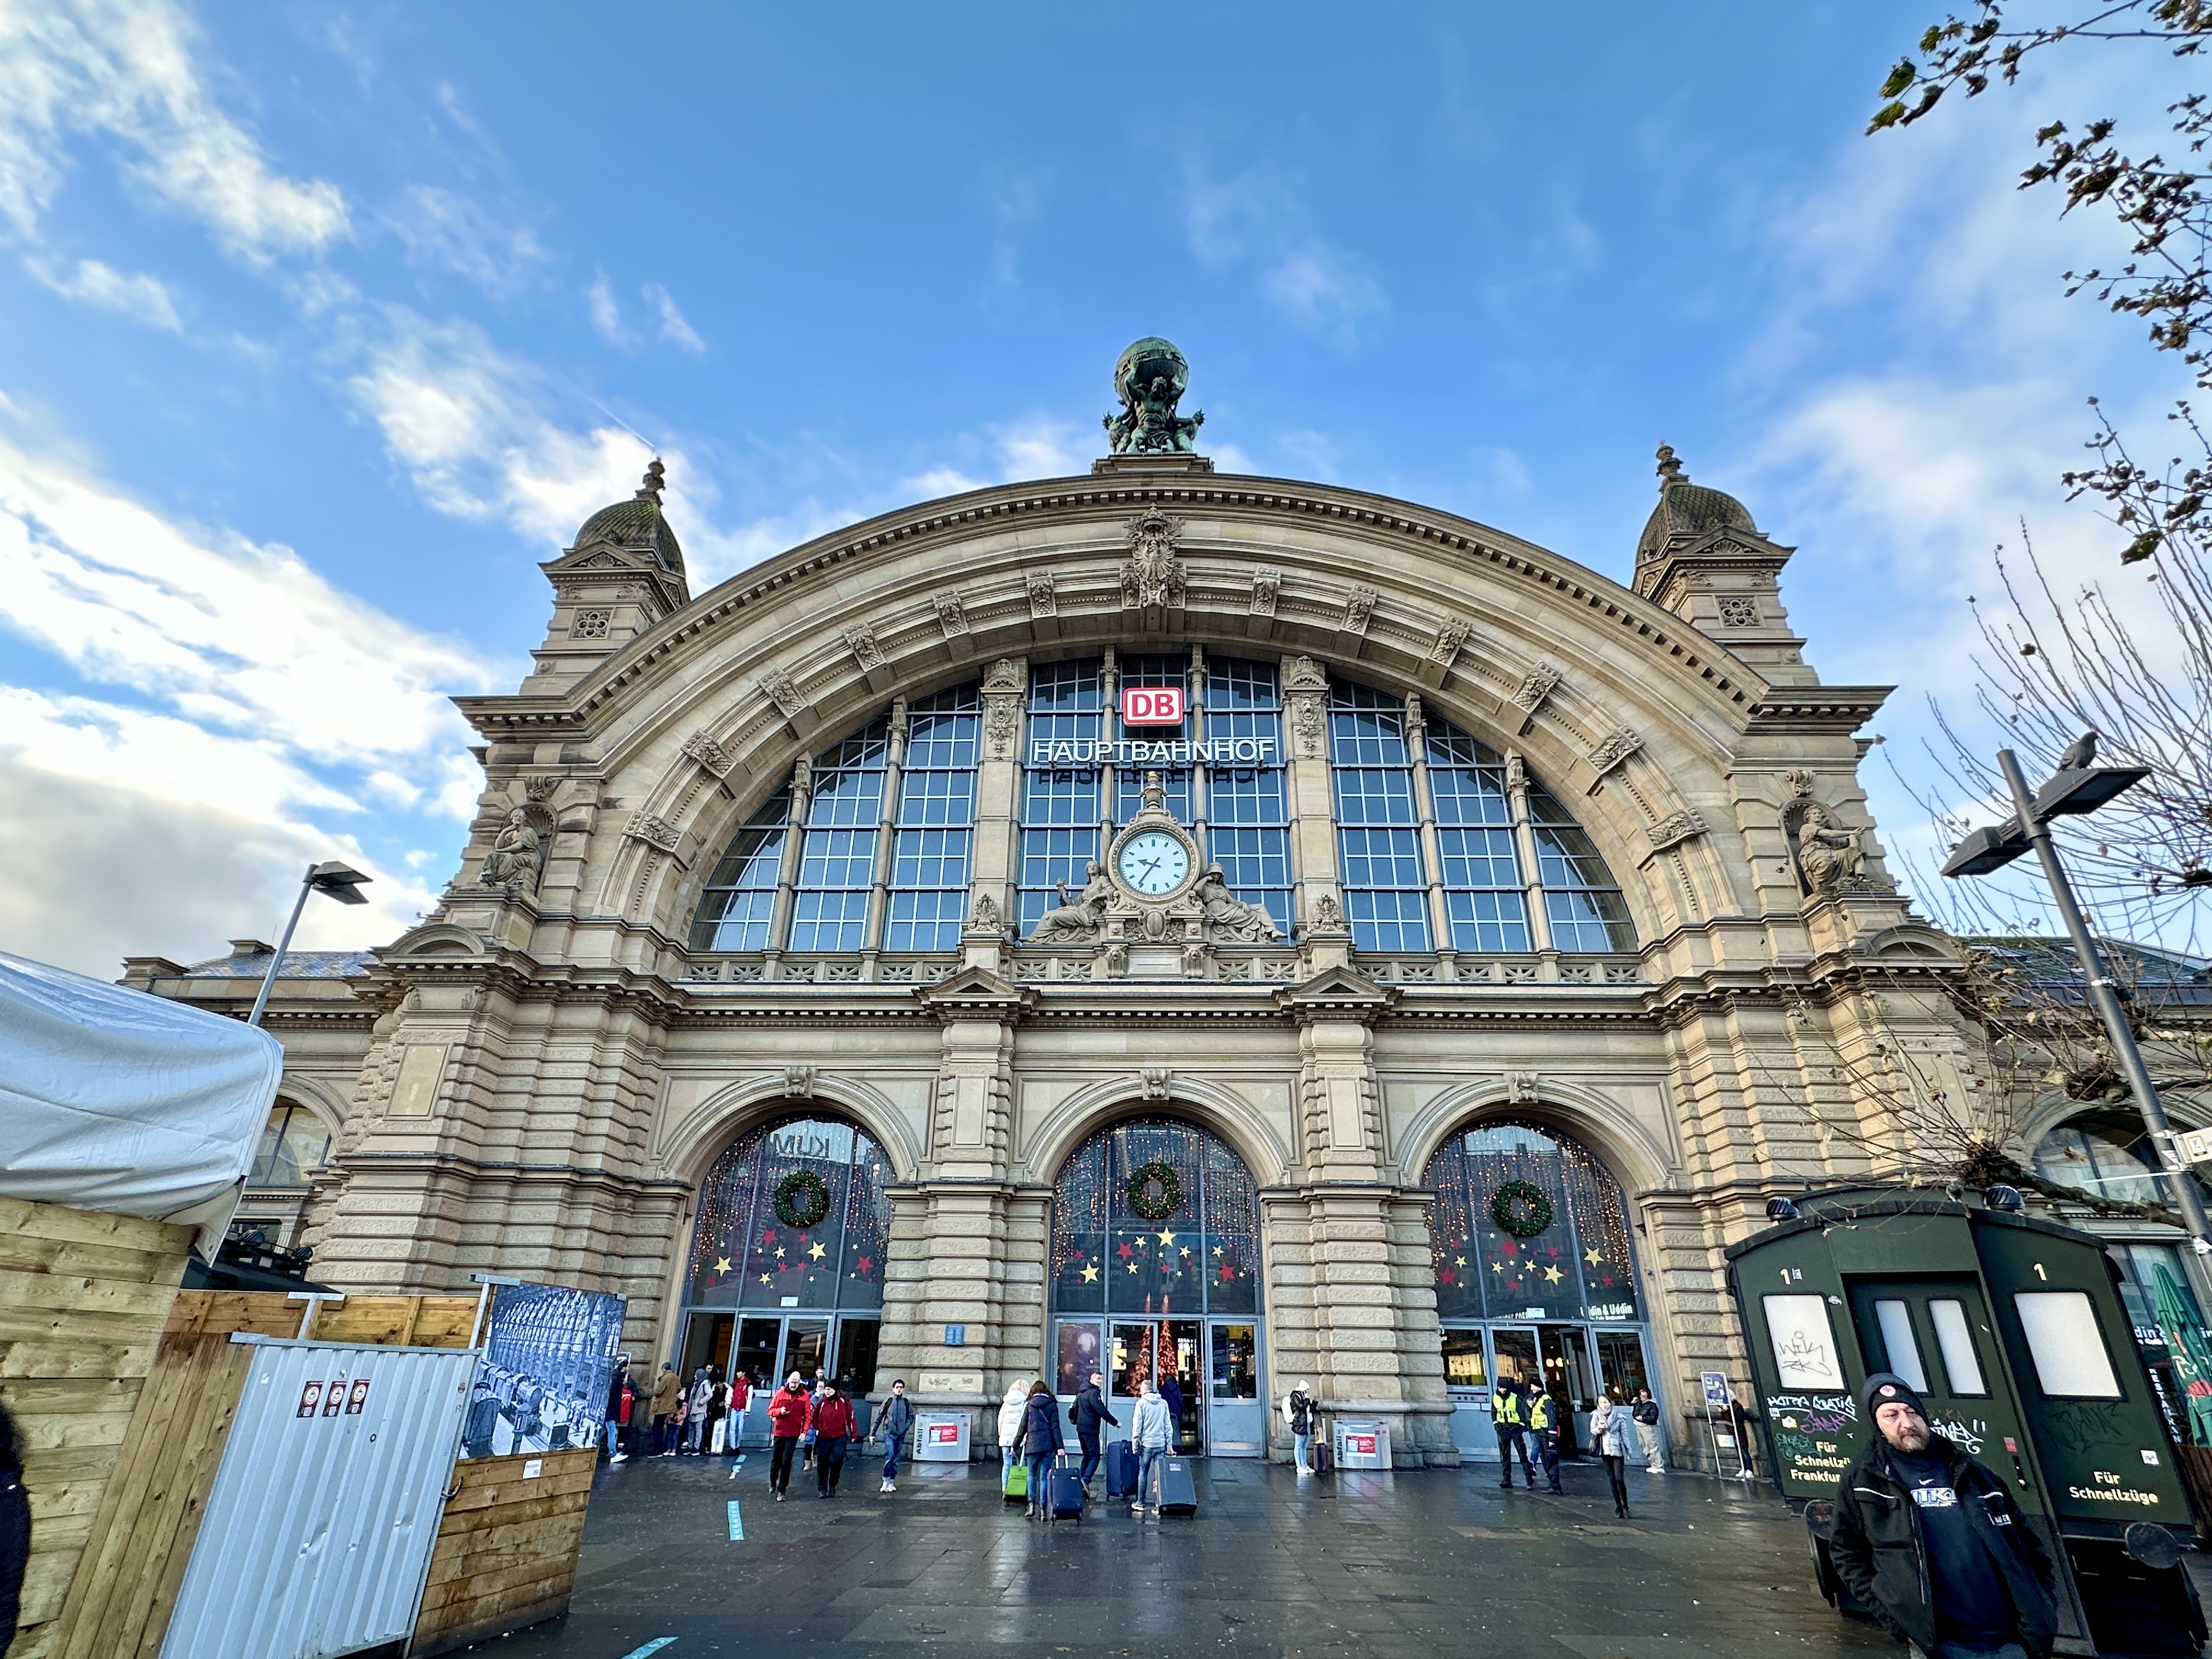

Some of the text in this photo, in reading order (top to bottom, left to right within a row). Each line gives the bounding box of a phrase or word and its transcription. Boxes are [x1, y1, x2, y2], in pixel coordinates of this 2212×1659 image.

[1131, 693, 1175, 717] DB
[1034, 739, 1274, 762] HAUPTBAHNHOF
[1780, 1268, 1791, 1285] 1
[2033, 1263, 2047, 1281] 1
[1602, 1304, 1609, 1316] &
[1609, 1302, 1633, 1315] Uddin
[2148, 1368, 2182, 1443] RESTAURAN
[1815, 1441, 1837, 1454] Für
[1790, 1468, 1841, 1483] Frankfur
[2093, 1471, 2121, 1485] Für
[2069, 1486, 2158, 1505] Schnellzüge
